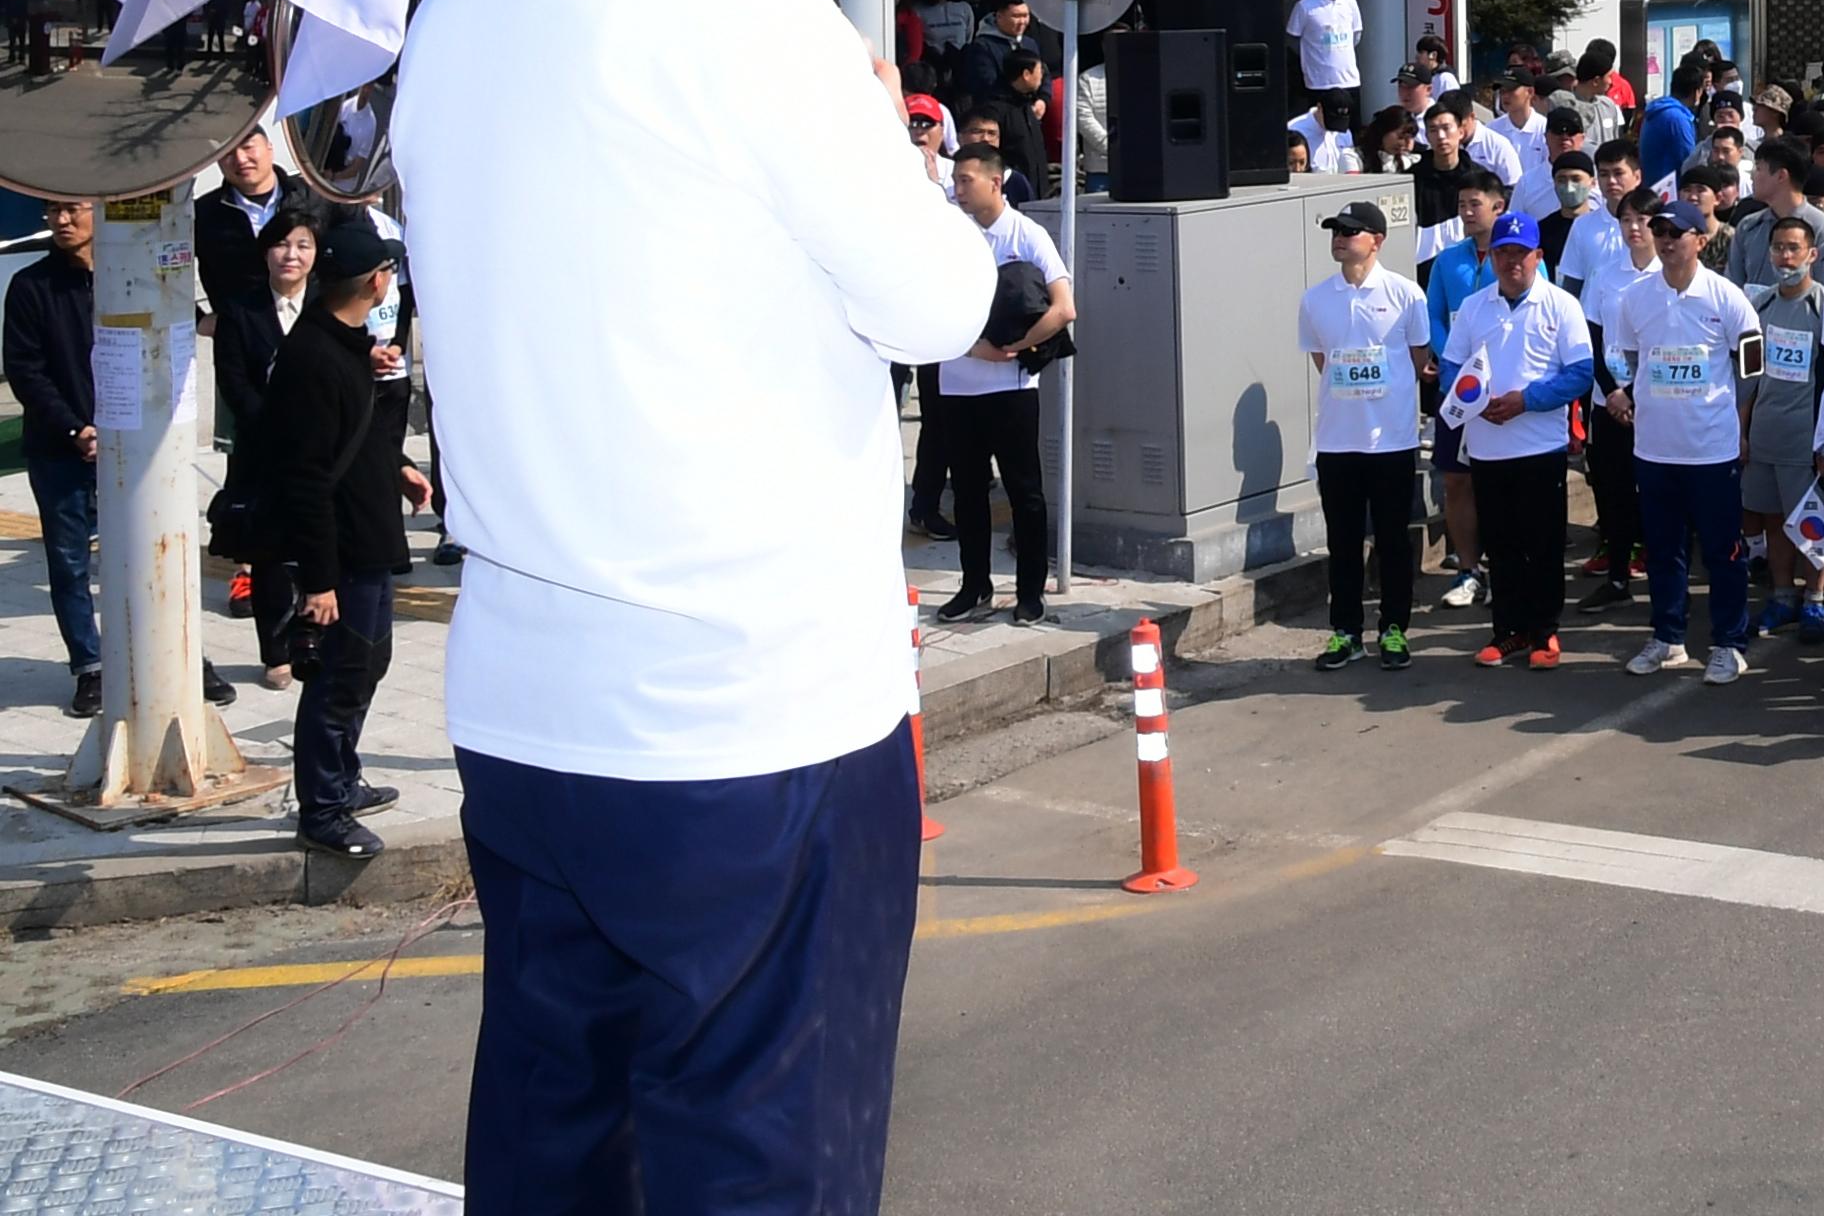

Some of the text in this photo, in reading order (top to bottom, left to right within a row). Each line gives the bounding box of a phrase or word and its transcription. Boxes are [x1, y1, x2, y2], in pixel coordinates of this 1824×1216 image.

[1391, 205, 1408, 223] S22
[1774, 346, 1804, 364] 723
[1349, 365, 1381, 382] 648
[1669, 364, 1702, 380] 778
